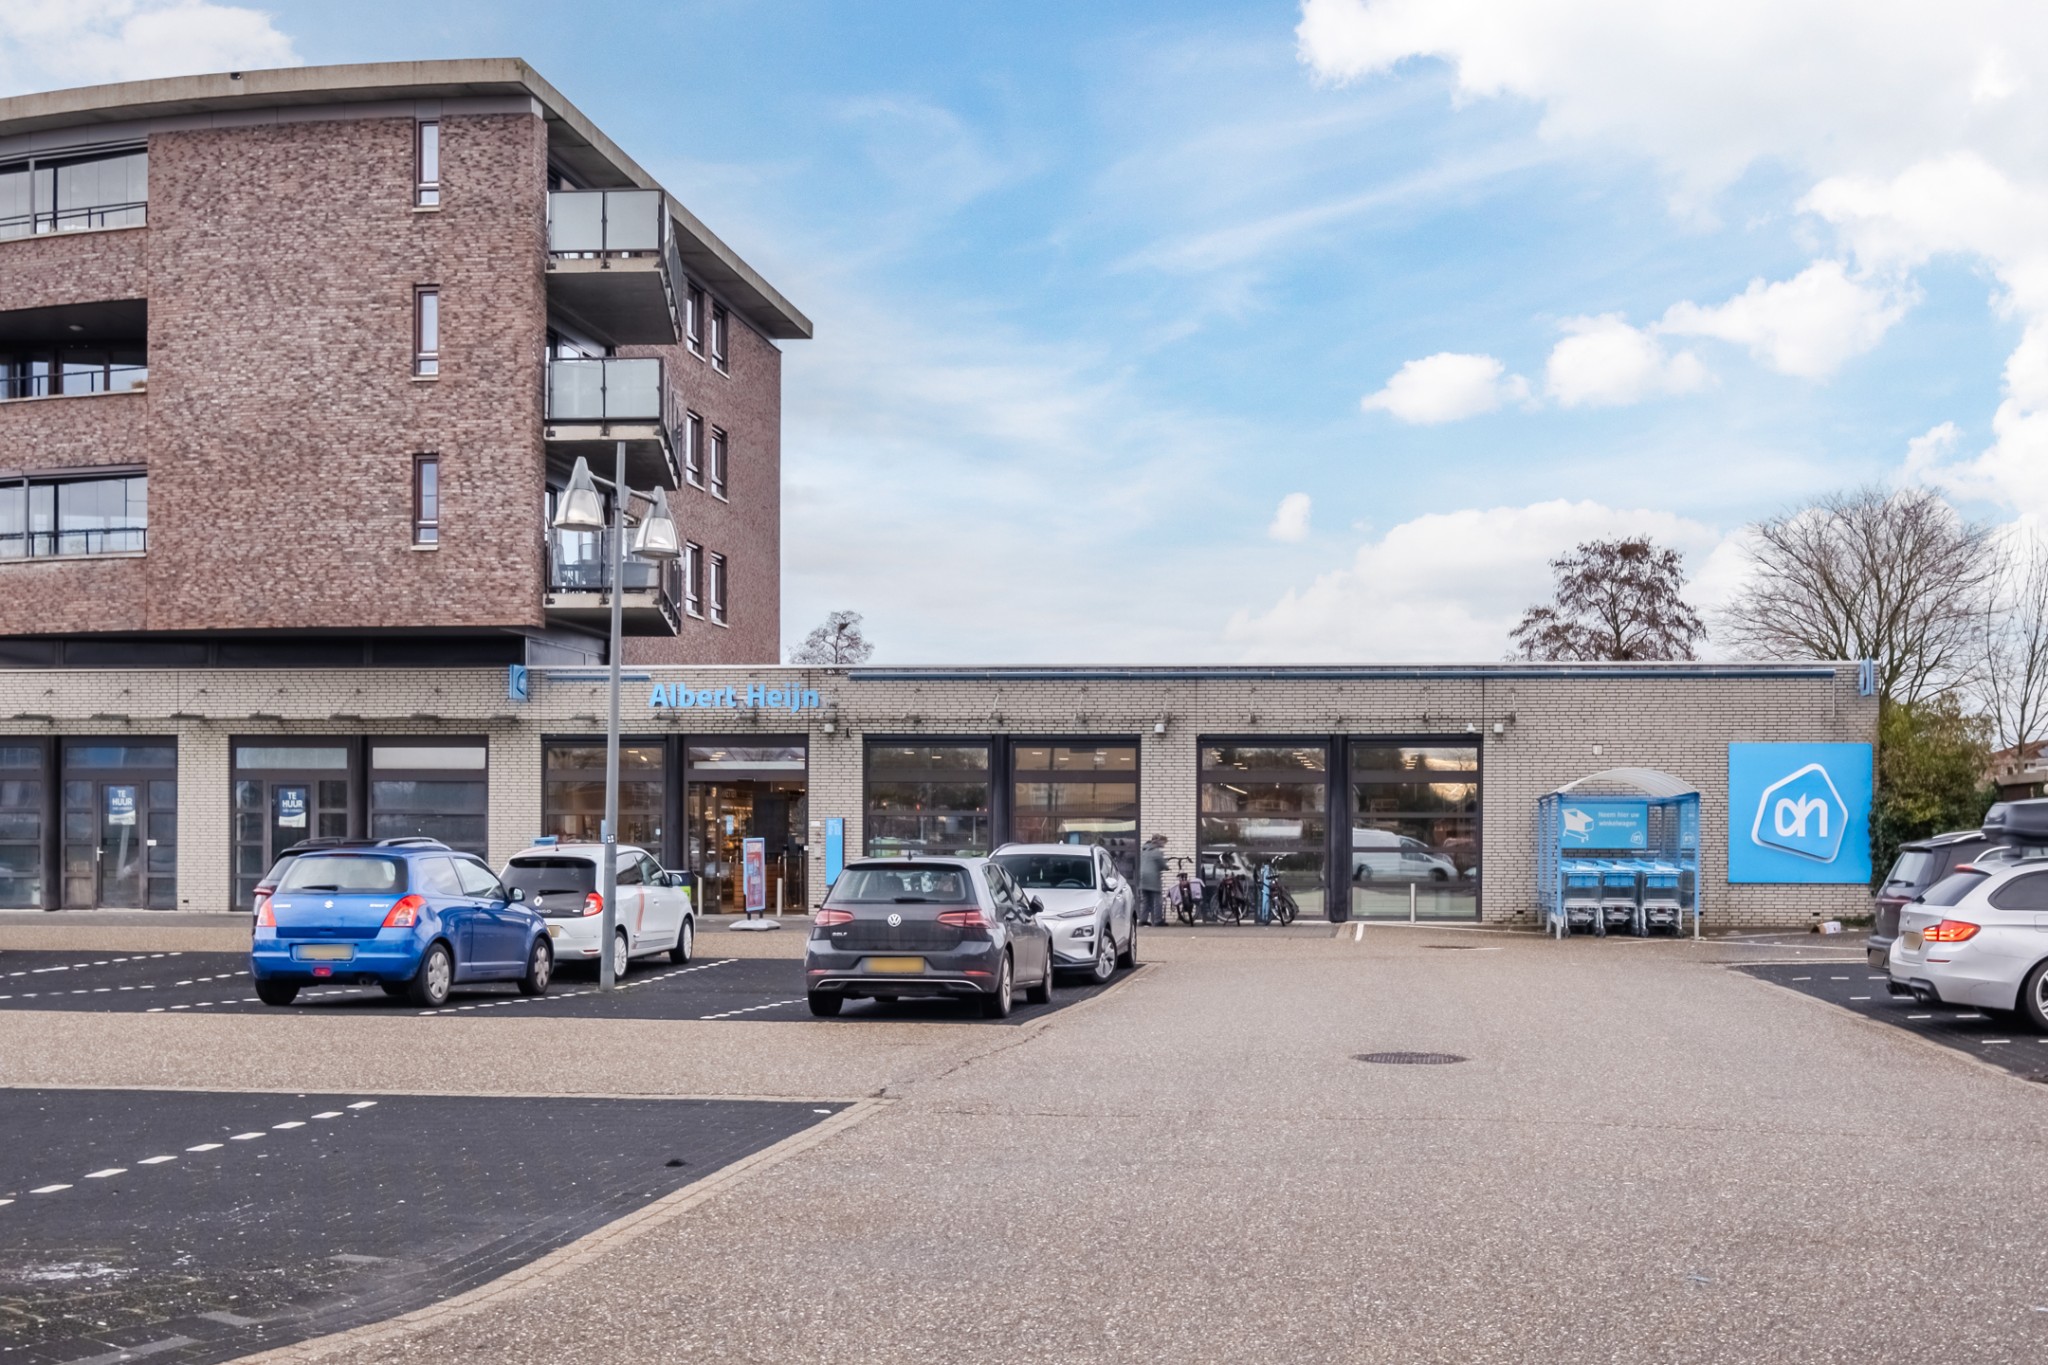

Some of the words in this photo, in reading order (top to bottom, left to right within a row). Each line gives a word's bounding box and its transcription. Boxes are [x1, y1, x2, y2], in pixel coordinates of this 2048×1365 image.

[650, 683, 737, 708] Albert
[746, 682, 820, 714] Heijn
[117, 789, 127, 798] TE
[287, 791, 297, 800] TE
[112, 797, 133, 806] HUUR
[282, 799, 303, 809] HUUR
